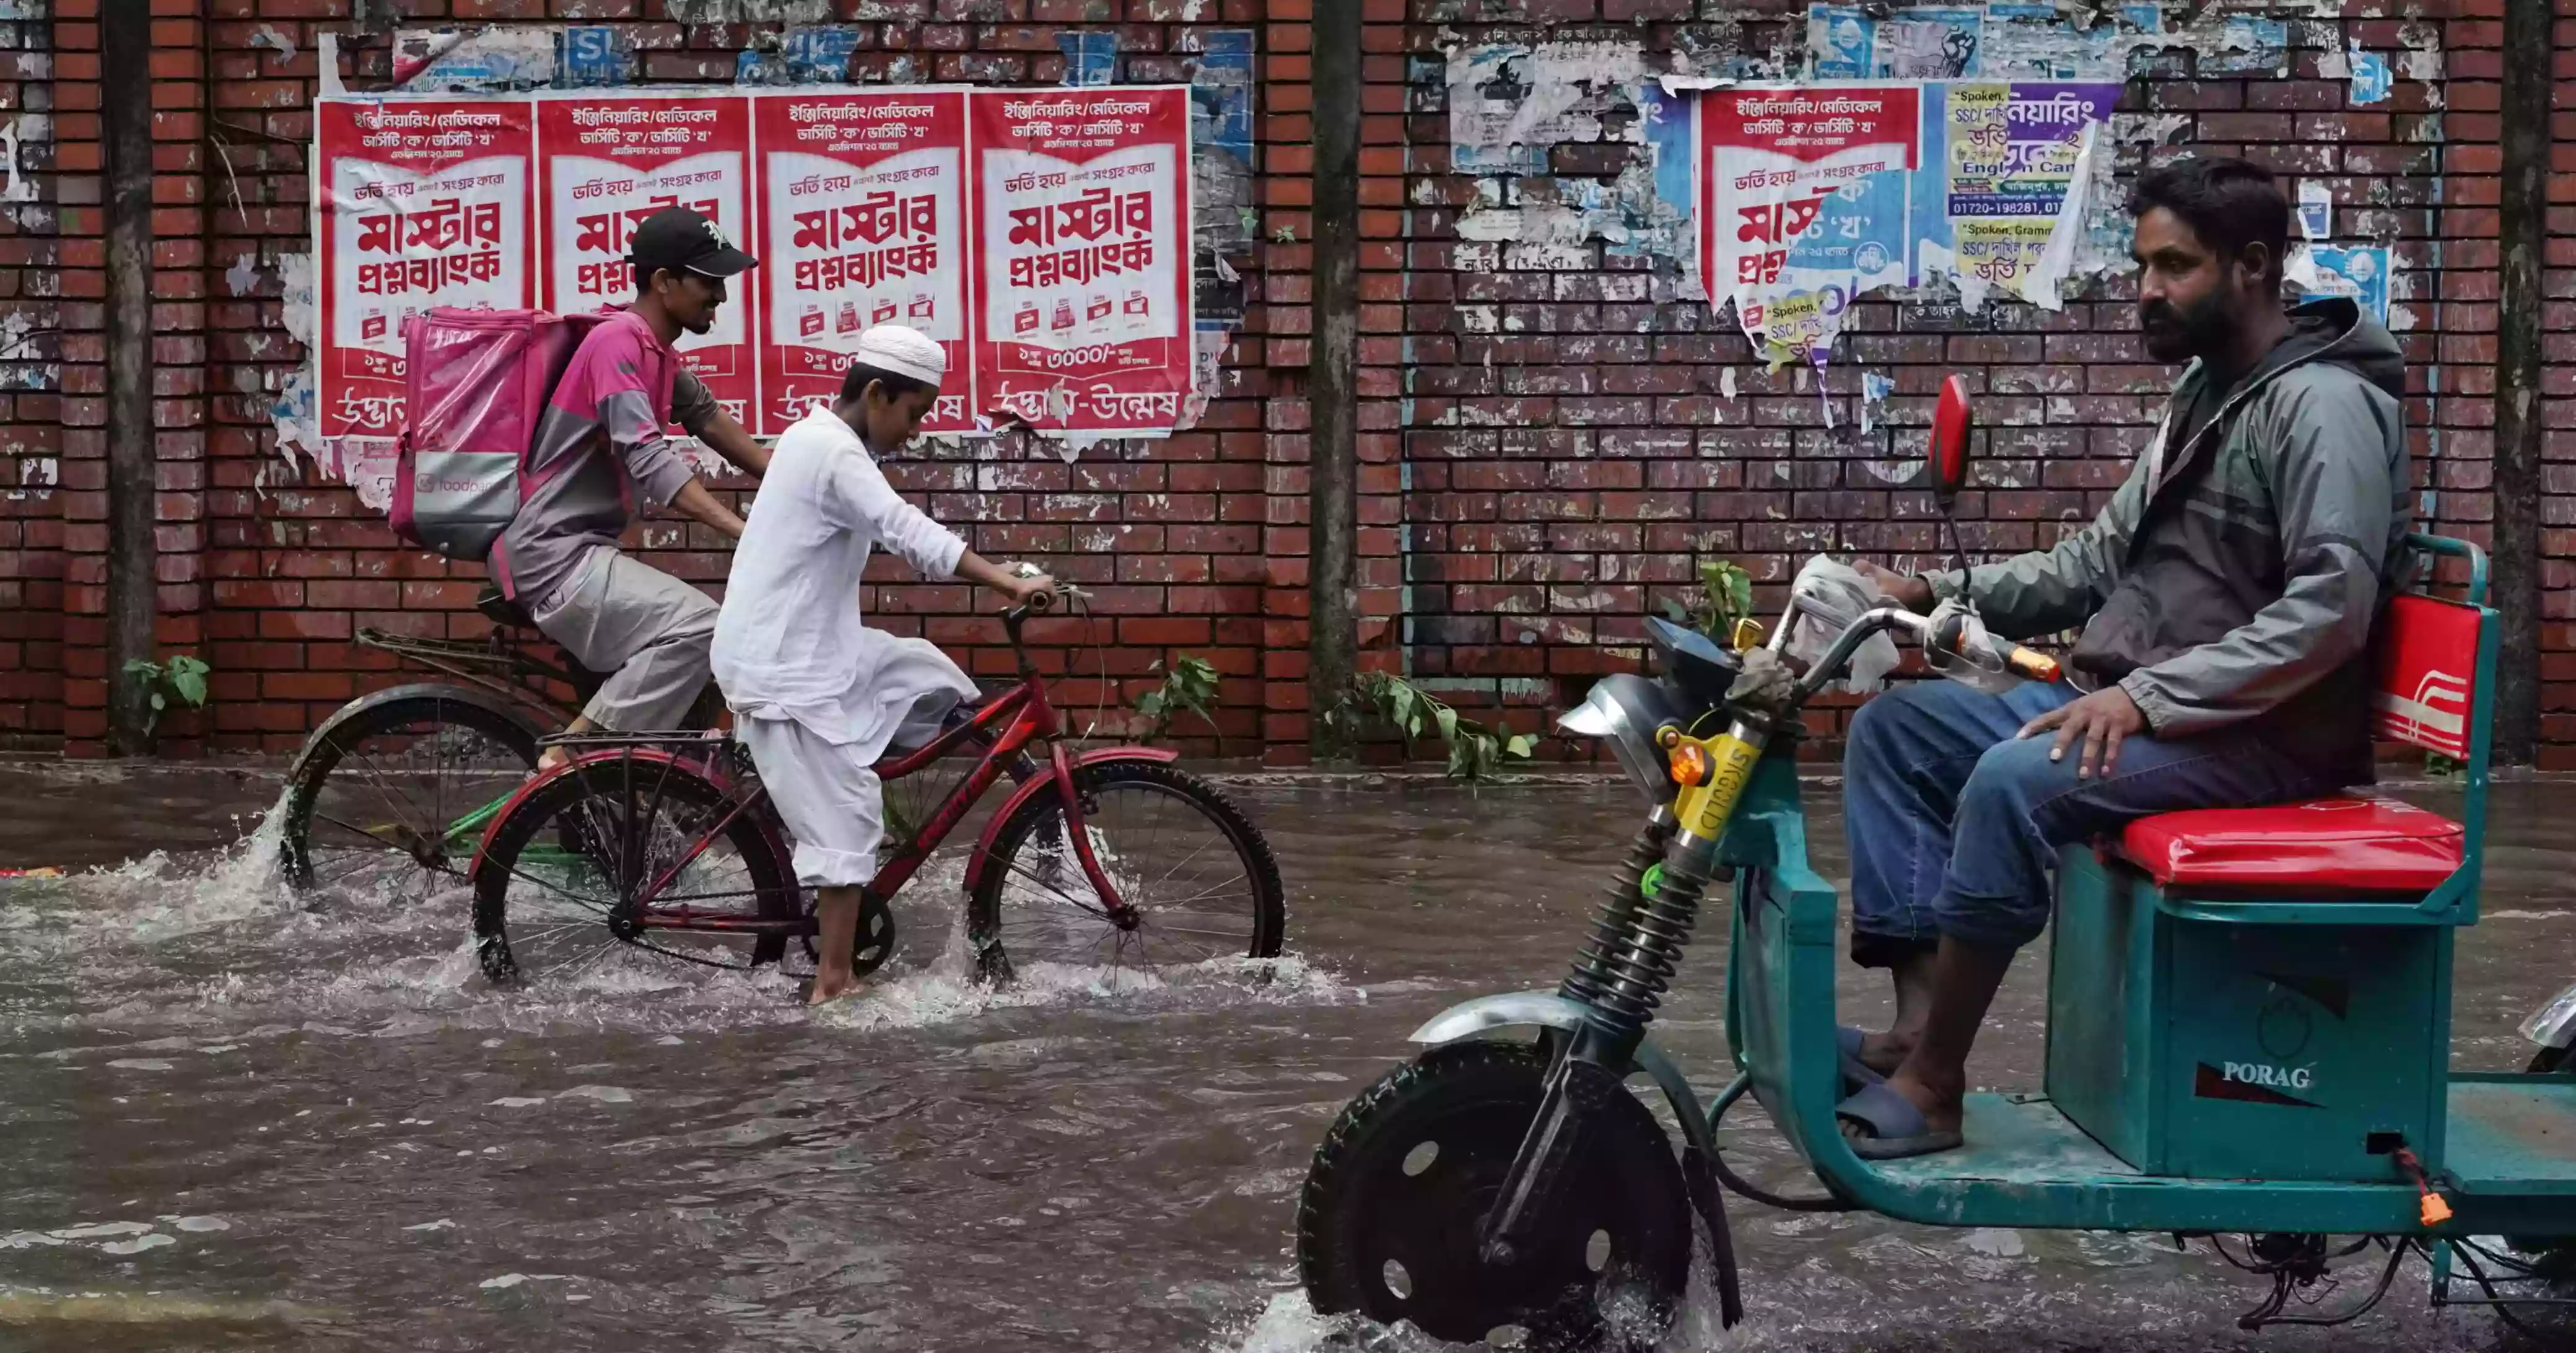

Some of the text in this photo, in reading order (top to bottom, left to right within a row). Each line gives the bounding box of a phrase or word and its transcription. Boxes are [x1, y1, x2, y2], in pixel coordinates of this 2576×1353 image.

[354, 181, 383, 200] ভর্তি
[387, 182, 414, 198] হয়ে
[442, 177, 474, 190] সংগ্রহ
[573, 178, 603, 199] ভর্তি
[607, 179, 634, 195] হয়ে
[660, 174, 692, 188] সংগ্রহ
[790, 174, 820, 196] ভর্তি
[824, 175, 851, 191] হয়ে
[877, 170, 909, 184] সংগ্রহ
[1005, 170, 1035, 193] ভর্তি
[1039, 172, 1067, 190] হয়ে
[1093, 167, 1125, 180] সংগ্রহ
[1735, 169, 1766, 190] ভর্তি
[1770, 170, 1797, 186] হয়ে
[1823, 164, 1855, 178] সংগ্রহ
[358, 198, 500, 255] মাস্টার
[793, 190, 937, 252] মাস্টার
[1009, 187, 1152, 248] মাস্টার
[359, 250, 500, 296] প্রশ্নব্যাংক
[795, 242, 937, 291] প্রশ্নব্যাংক
[1010, 239, 1153, 289] প্রশ্নব্যাংক
[2222, 1061, 2312, 1088] PORAG
